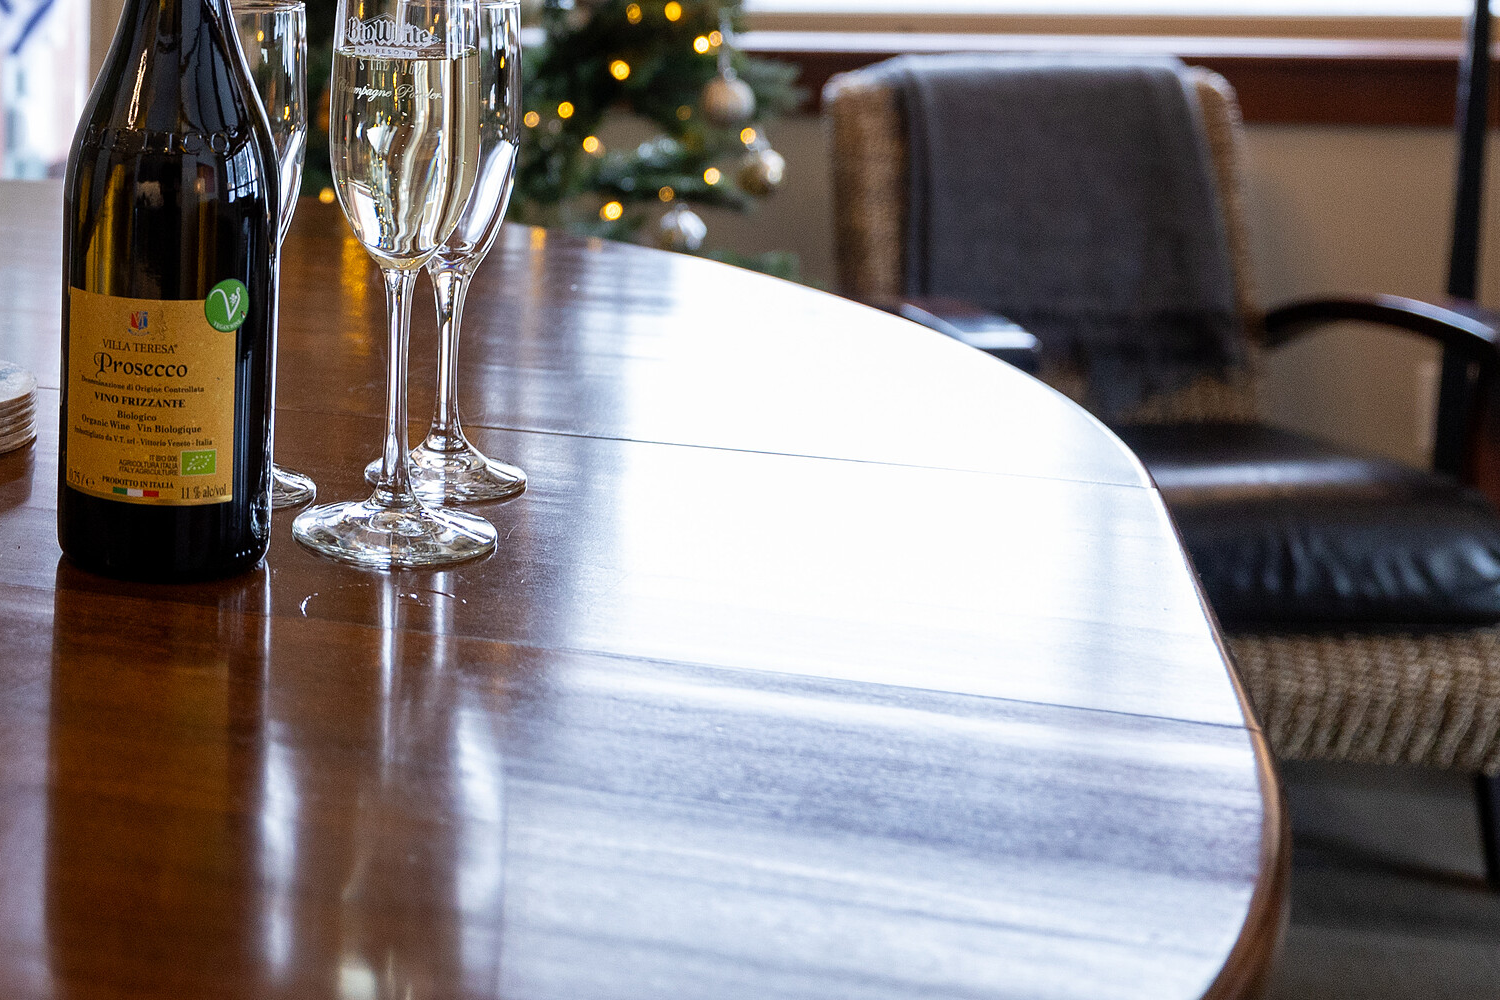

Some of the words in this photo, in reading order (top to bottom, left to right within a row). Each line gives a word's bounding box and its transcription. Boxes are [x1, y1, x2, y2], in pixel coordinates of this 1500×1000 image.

[338, 77, 393, 102] Champagne
[102, 339, 130, 351] VILLA
[93, 352, 188, 378] Prosecco
[81, 375, 125, 390] Denominazione
[135, 385, 163, 394] Origine
[94, 391, 119, 404] VINO
[121, 395, 186, 408] FRIZZANTE
[117, 410, 157, 422] Biologico
[81, 413, 109, 426] Organic
[110, 420, 130, 430] Wine
[137, 424, 152, 433] Vin
[155, 425, 202, 435] Biologique
[104, 433, 113, 442] da
[140, 438, 167, 447] Vittorio
[167, 438, 191, 447] Veneto
[195, 438, 213, 446] Italia
[118, 459, 160, 468] AGRICOLTURA
[118, 465, 134, 473] ITALY
[134, 468, 179, 476] AGRICULTURE
[102, 475, 138, 487] PRODOTTO
[139, 480, 148, 488] IN
[149, 480, 174, 489] ITALIA
[181, 486, 190, 499] 11
